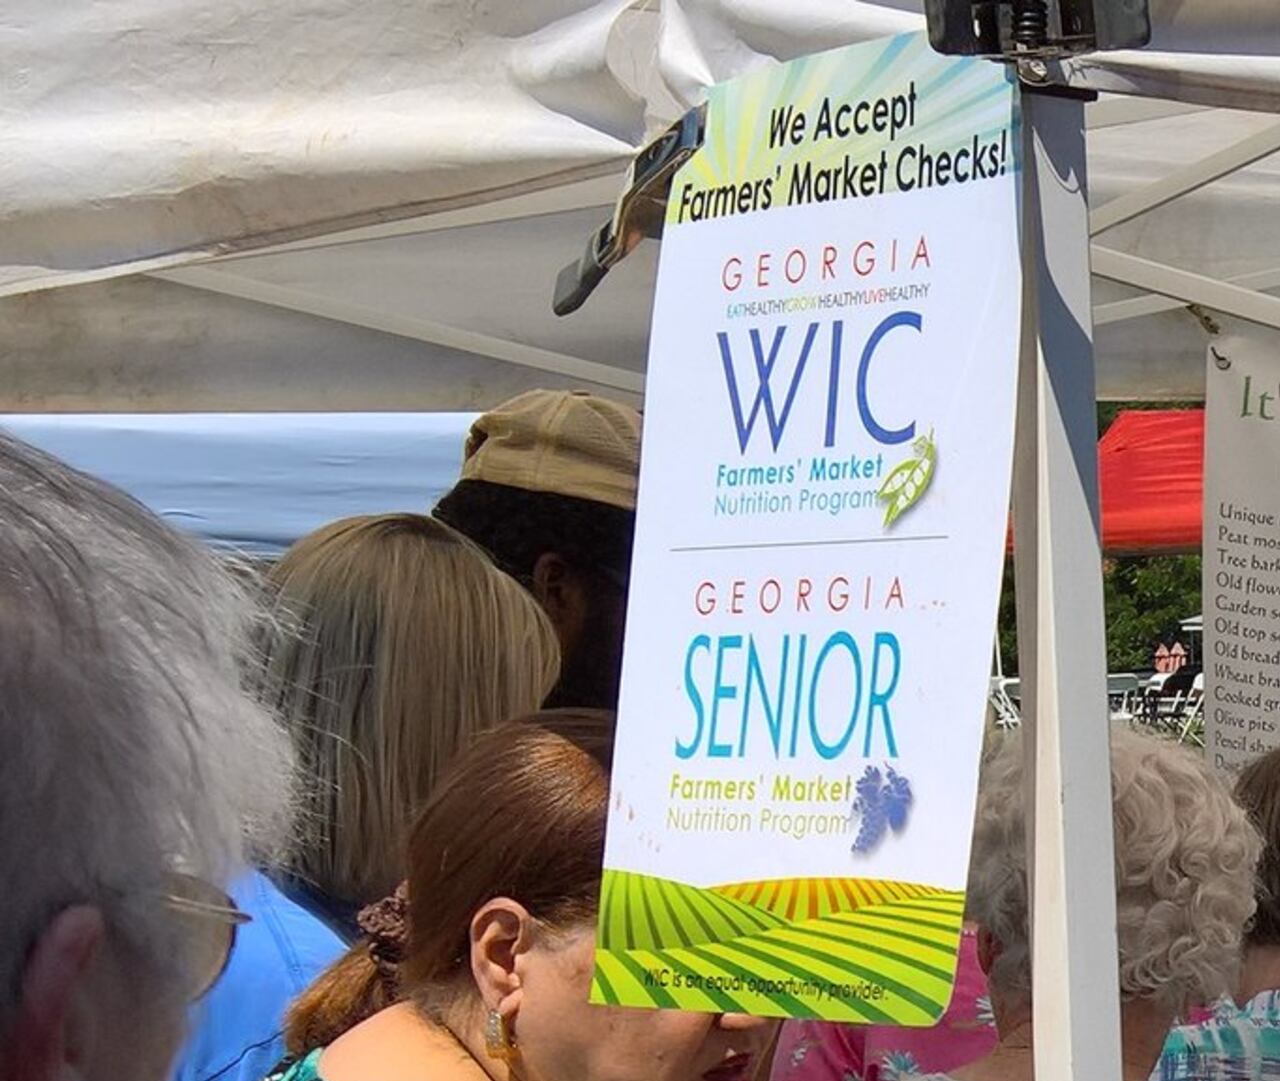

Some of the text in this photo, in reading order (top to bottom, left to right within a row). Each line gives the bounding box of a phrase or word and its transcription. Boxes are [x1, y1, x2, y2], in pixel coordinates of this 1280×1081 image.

[769, 81, 917, 149] We Accept
[677, 130, 1008, 224] Farmers' Market Checks!
[722, 236, 932, 292] GEORGIA
[716, 310, 923, 455] WIC
[716, 455, 884, 488] Farmers' Market
[713, 488, 880, 520] Nutrition Program
[1219, 502, 1275, 526] Unique
[1218, 524, 1249, 545] Peat
[1216, 547, 1248, 569] Tree
[1215, 570, 1243, 590] Old
[695, 575, 906, 616] GEORGIA
[1214, 593, 1267, 618] Garden
[1214, 616, 1240, 637] Old
[1241, 626, 1266, 645] top
[1213, 640, 1280, 666] Old bread
[1214, 662, 1255, 686] Wheat
[674, 630, 903, 760] SENIOR
[1213, 684, 1262, 708] Cooked
[1213, 707, 1276, 732] Olive pits
[1214, 729, 1247, 752] Pencil
[669, 774, 852, 802] Farmers' Market
[665, 806, 851, 840] Nutrition Program
[643, 967, 889, 1002] WIC is an equal opportunity provider.
